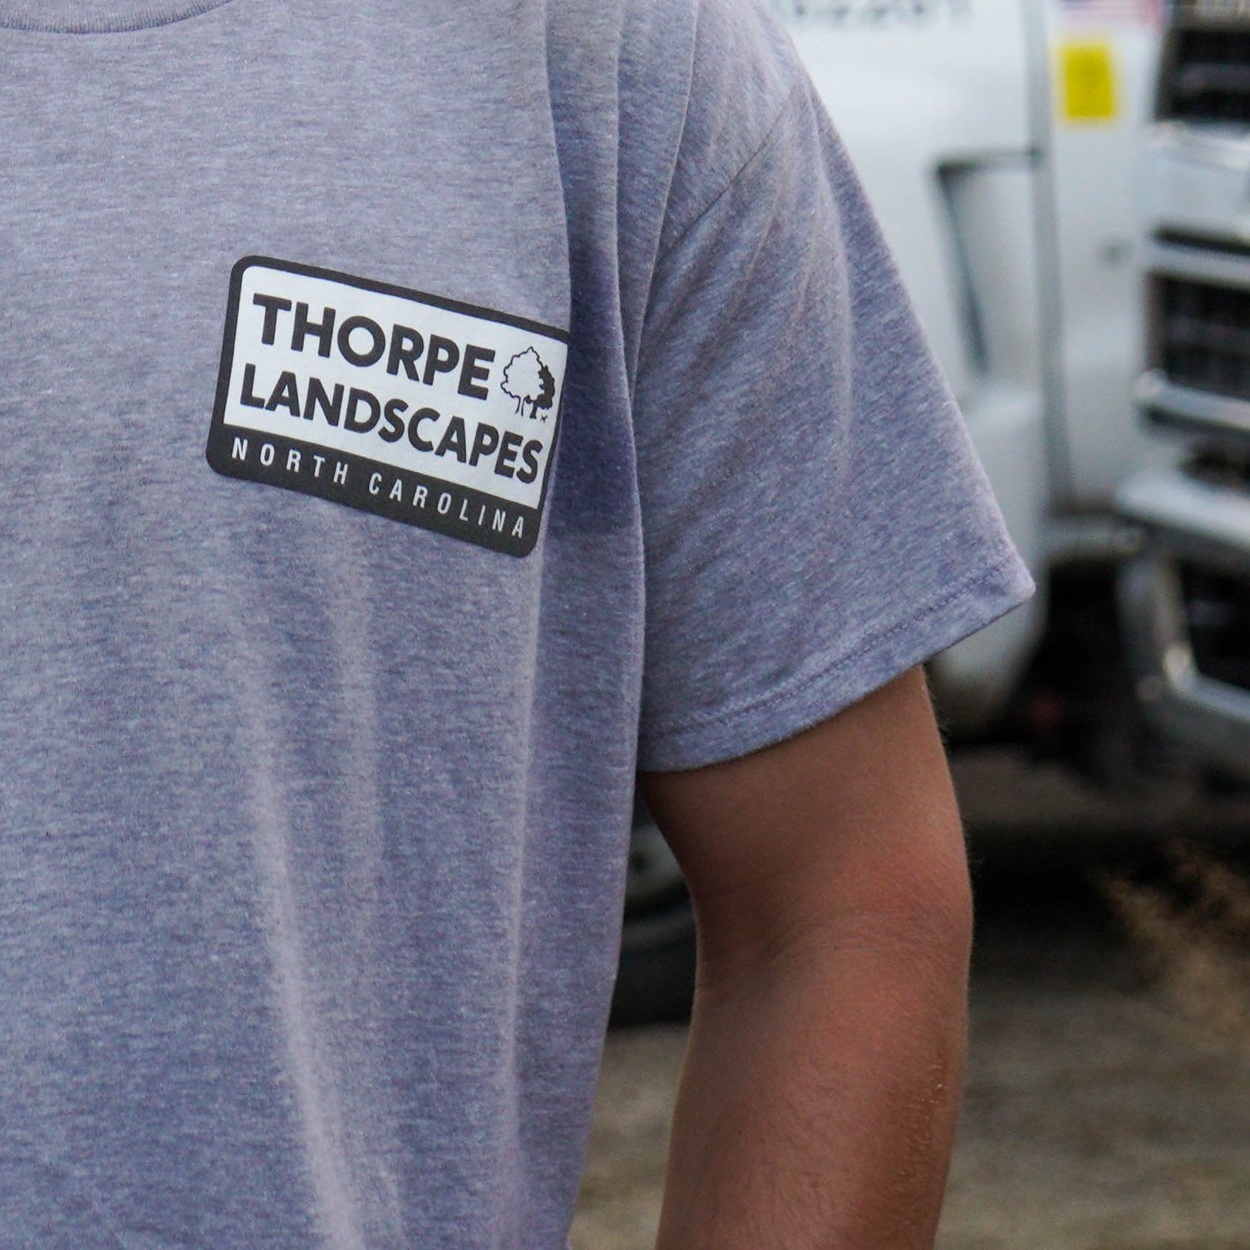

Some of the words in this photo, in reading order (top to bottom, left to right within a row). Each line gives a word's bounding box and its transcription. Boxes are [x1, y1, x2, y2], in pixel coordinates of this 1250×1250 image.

[252, 292, 496, 400] THORPE
[239, 363, 544, 485] LANDSCAPES
[231, 436, 349, 485] NORTH
[368, 472, 525, 539] CAROLINA
